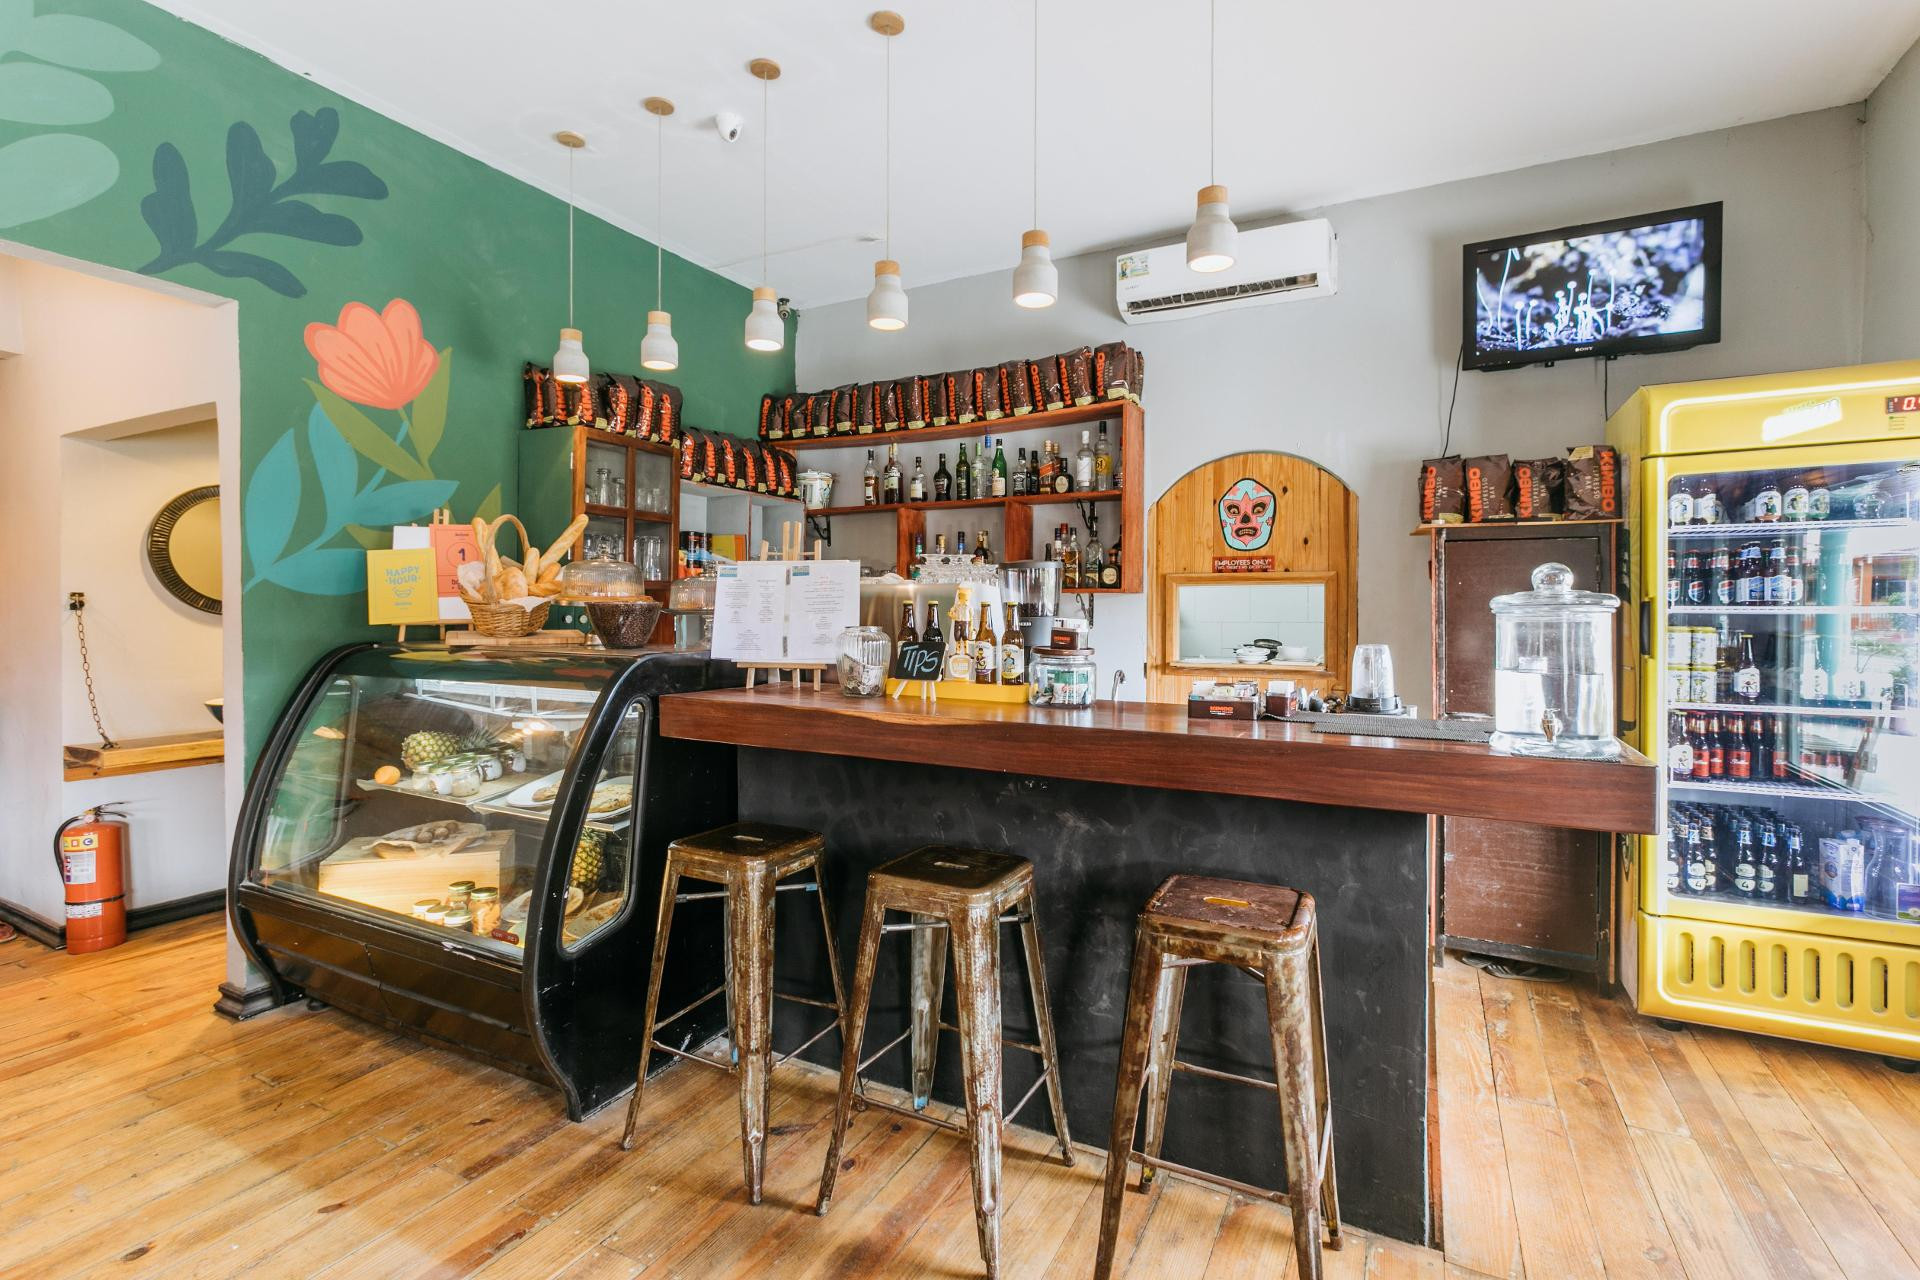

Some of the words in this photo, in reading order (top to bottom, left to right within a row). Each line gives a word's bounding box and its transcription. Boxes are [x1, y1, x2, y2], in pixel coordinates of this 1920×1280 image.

[975, 372, 984, 416] KIMBO
[1000, 367, 1011, 415] KIMBO
[1030, 363, 1044, 411] KIMBO
[1060, 358, 1072, 405] KIMBO
[1096, 351, 1105, 397] KIMBO
[760, 398, 771, 435] KIMBO
[783, 398, 792, 434] KIMBO
[874, 385, 882, 428] KIMBO
[896, 384, 905, 428] KIMBO
[922, 379, 931, 423] KIMBO
[948, 376, 957, 421] KIMBO
[1423, 466, 1436, 520] KIMBO
[1469, 467, 1482, 523] KIMBO
[1519, 467, 1533, 518] KIMBO
[1532, 477, 1540, 507] ESPRESSO
[1540, 484, 1548, 497] BAR
[1584, 475, 1592, 490] BAR
[1600, 450, 1615, 511] KIMBO
[386, 565, 420, 576] HAPPY
[458, 548, 465, 561] 1
[389, 574, 417, 585] HOUR
[903, 645, 940, 676] TIPS
